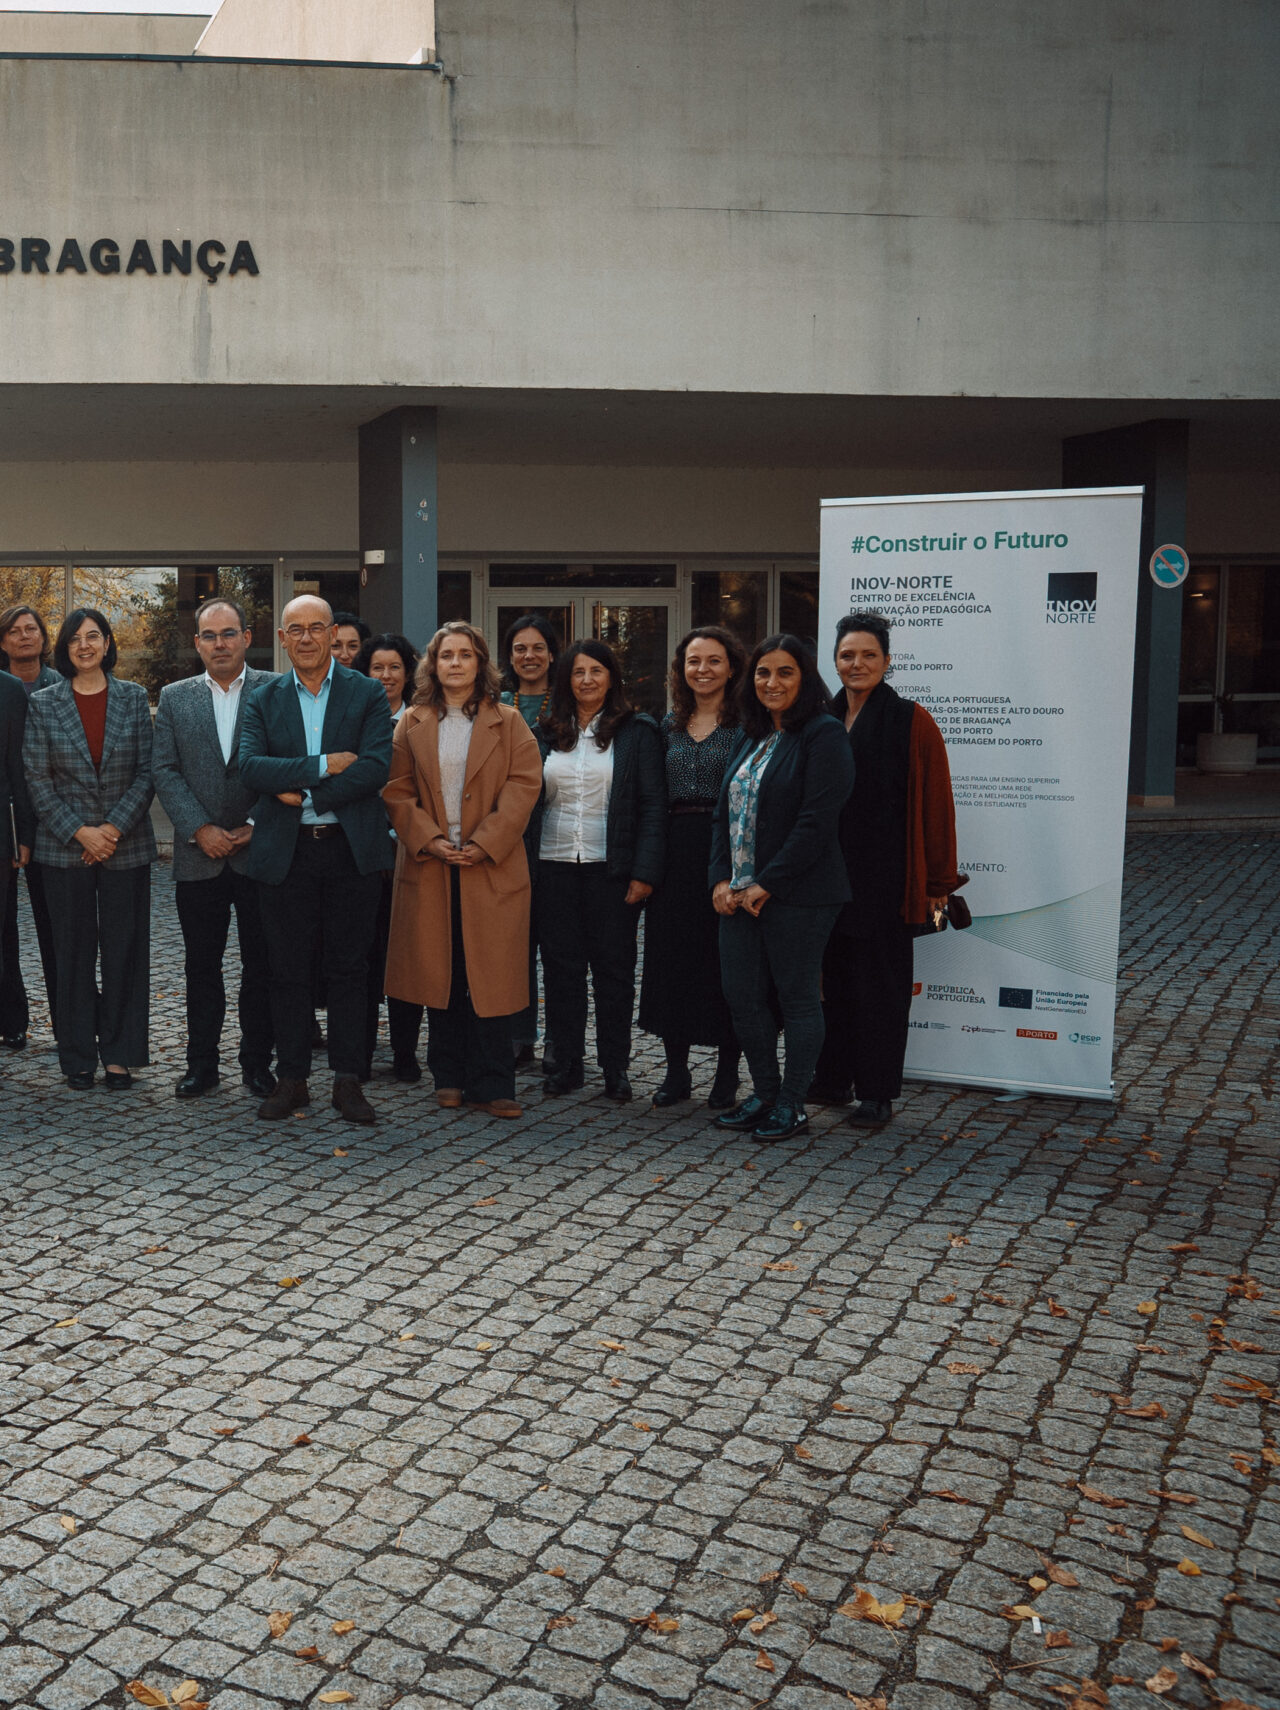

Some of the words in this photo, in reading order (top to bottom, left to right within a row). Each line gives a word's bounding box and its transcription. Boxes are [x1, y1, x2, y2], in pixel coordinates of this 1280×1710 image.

[851, 532, 968, 554] #Construir
[973, 536, 987, 550] o
[994, 531, 1069, 550] Futuro
[851, 575, 953, 590] INOV-NORTE
[850, 593, 892, 603] CENTRO
[894, 593, 908, 602] DE
[910, 590, 976, 602] EXCELÊNCIA
[850, 606, 863, 615] DE
[865, 604, 920, 616] INOVAÇÃO
[922, 603, 992, 614] PEDAGÓGICA
[1047, 600, 1097, 612] INOV
[908, 618, 944, 627] NORTE
[1046, 612, 1096, 624] NORTE
[910, 663, 922, 671] DO
[924, 663, 953, 671] PORTO
[908, 694, 951, 704] CATÓLICA
[952, 696, 1011, 704] PORTUGUESA
[922, 705, 999, 715] RÁS-OS-MONTES
[1008, 707, 1031, 715] ALTO
[1033, 707, 1064, 715] DOURO
[963, 717, 1011, 726] BRAGANÇA
[949, 727, 962, 735] DO
[964, 727, 993, 735] PORTO
[998, 738, 1011, 746] DO
[1013, 738, 1043, 746] PORTO
[1001, 776, 1026, 784] ENSINO
[1027, 777, 1060, 785] SUPERIOR
[1035, 794, 1075, 802] PROCESSOS
[984, 801, 1027, 809] ESTUDANTES
[927, 983, 975, 996] REPÚBLICA
[1036, 989, 1074, 999] Financiado
[1075, 992, 1090, 1000] pela
[927, 992, 986, 1004] PORTUGUESA
[1035, 996, 1055, 1005] União
